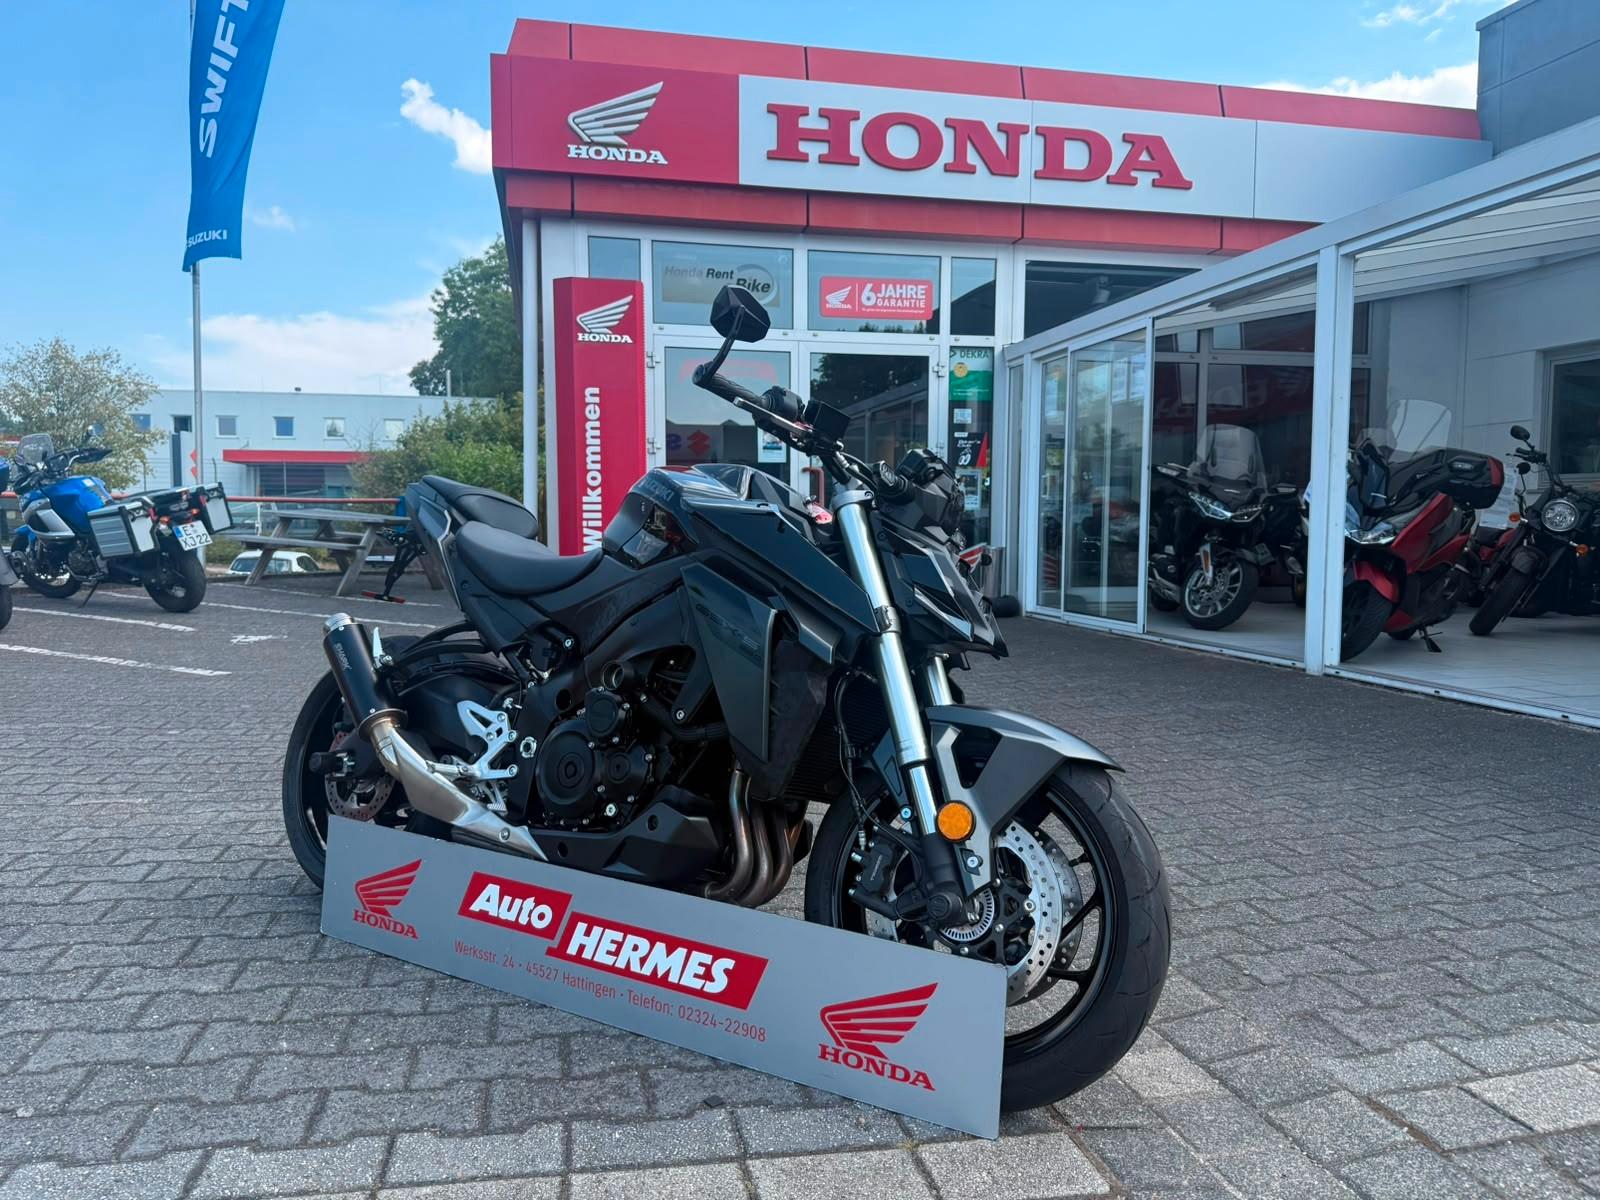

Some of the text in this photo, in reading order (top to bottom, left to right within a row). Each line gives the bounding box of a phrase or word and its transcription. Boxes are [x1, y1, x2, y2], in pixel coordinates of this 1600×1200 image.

[199, 0, 249, 158] SWIFT
[567, 144, 669, 164] HONDA
[766, 103, 1193, 191] HONDA
[186, 229, 228, 249] SUZUKI
[706, 268, 734, 279] Rent
[736, 278, 771, 293] Bike
[861, 283, 928, 306] 6 JAHRE
[877, 298, 926, 308] GARANTIE
[577, 332, 634, 343] HONDA
[960, 349, 989, 359] DEKRA
[582, 387, 603, 552] Willkommen
[469, 883, 553, 929] Auto
[353, 908, 419, 940] HONDA
[566, 921, 735, 994] HERMES
[454, 940, 767, 1042] Werksstr. 24 45527 Hattingen Telefon: 02324-22908
[817, 1043, 936, 1092] HONDA
